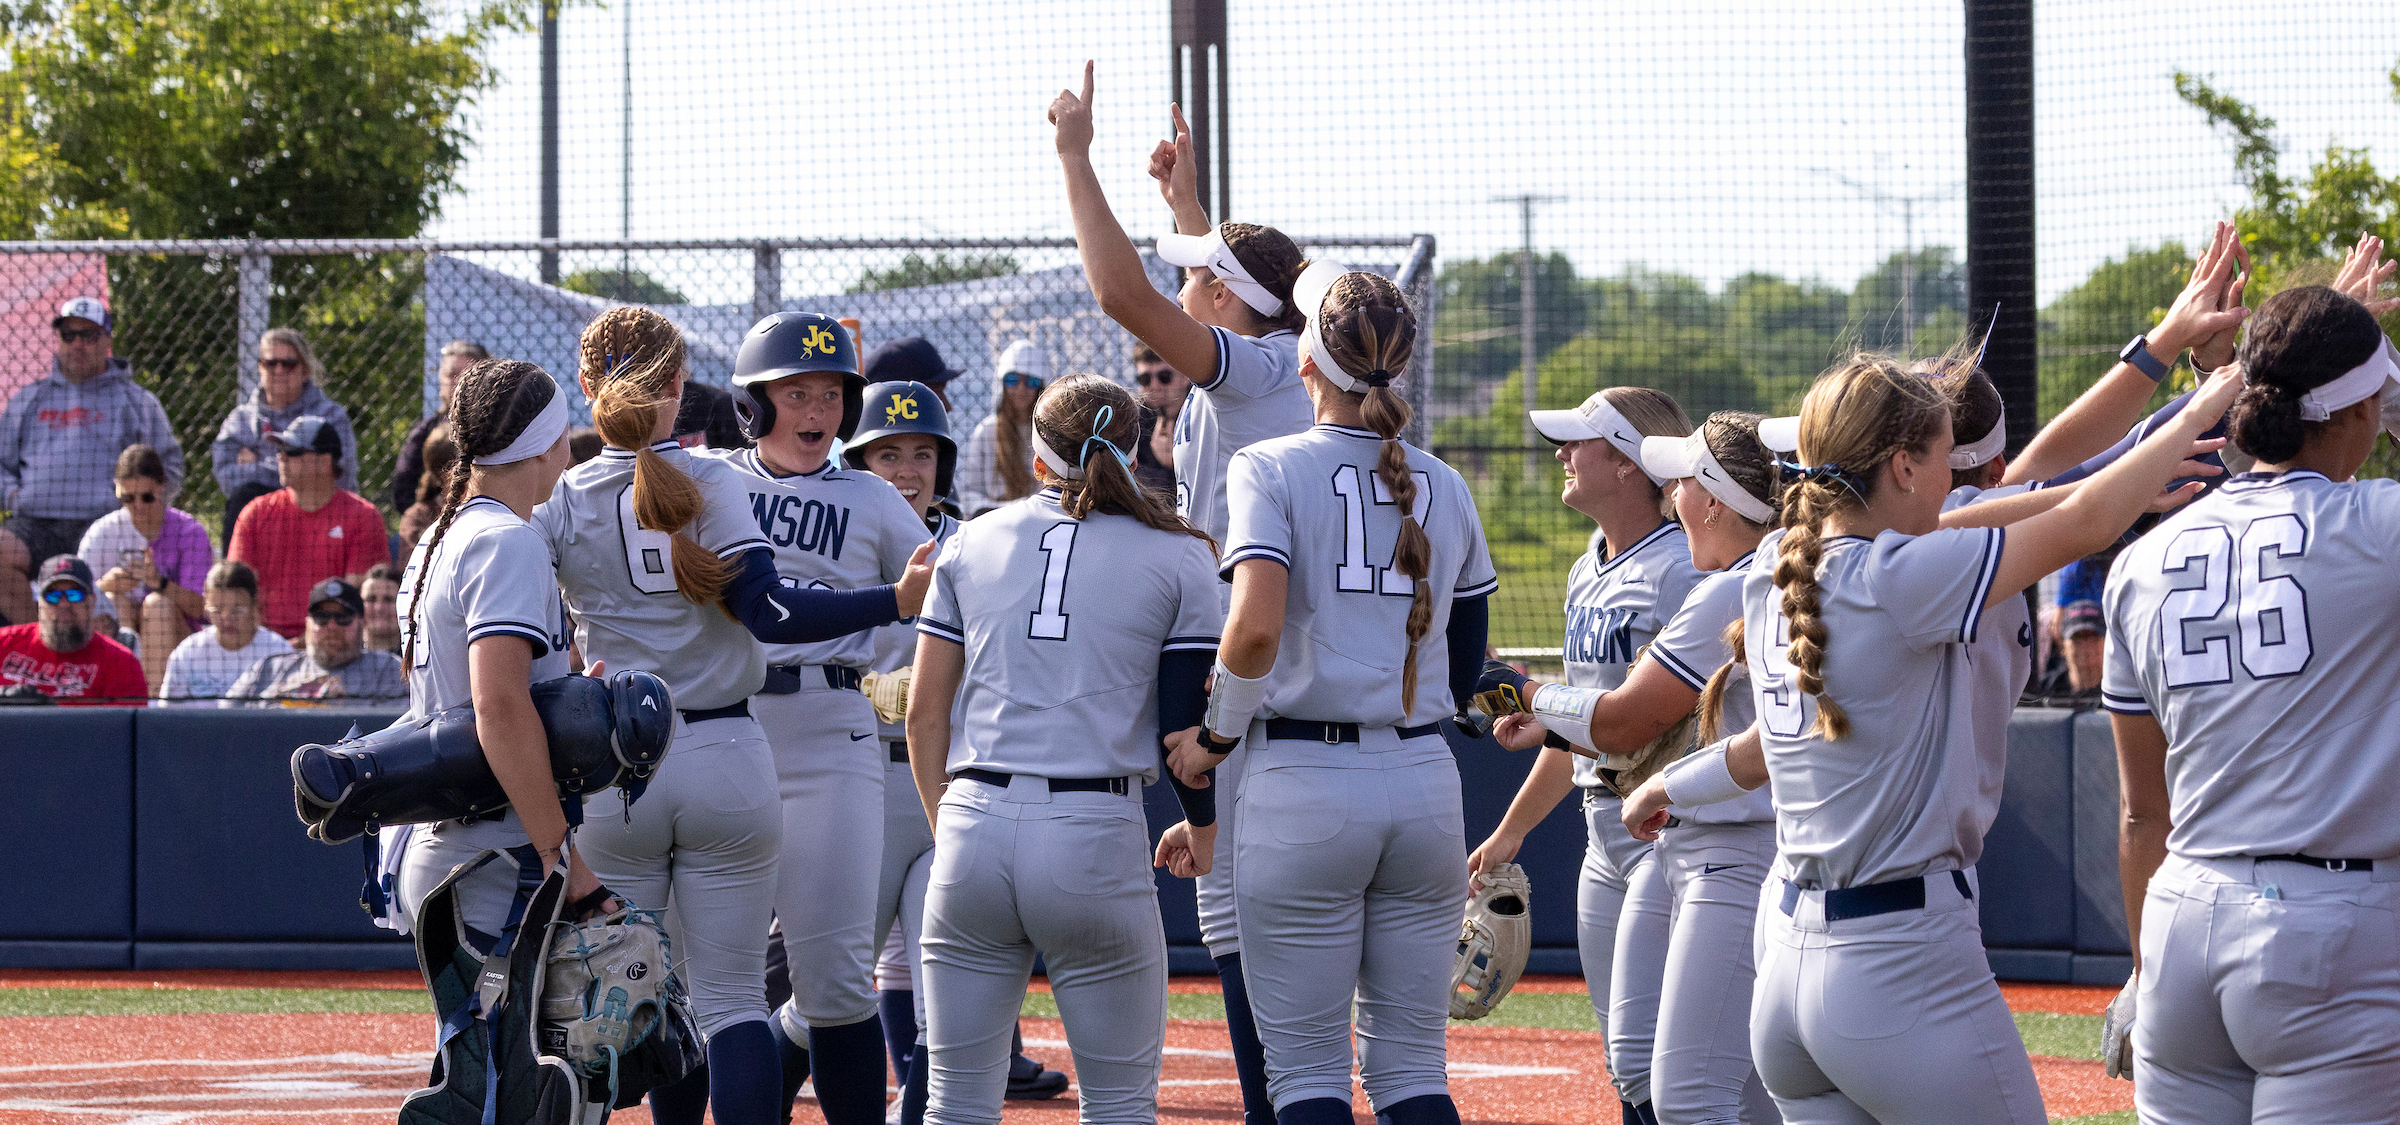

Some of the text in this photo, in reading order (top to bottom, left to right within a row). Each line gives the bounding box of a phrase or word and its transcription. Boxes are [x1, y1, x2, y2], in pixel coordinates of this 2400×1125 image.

[802, 325, 836, 355] JC
[886, 393, 919, 420] JC
[749, 492, 850, 561] NSON
[1331, 464, 1434, 598] 17
[1027, 521, 1079, 642] 1
[2160, 513, 2315, 691] 26
